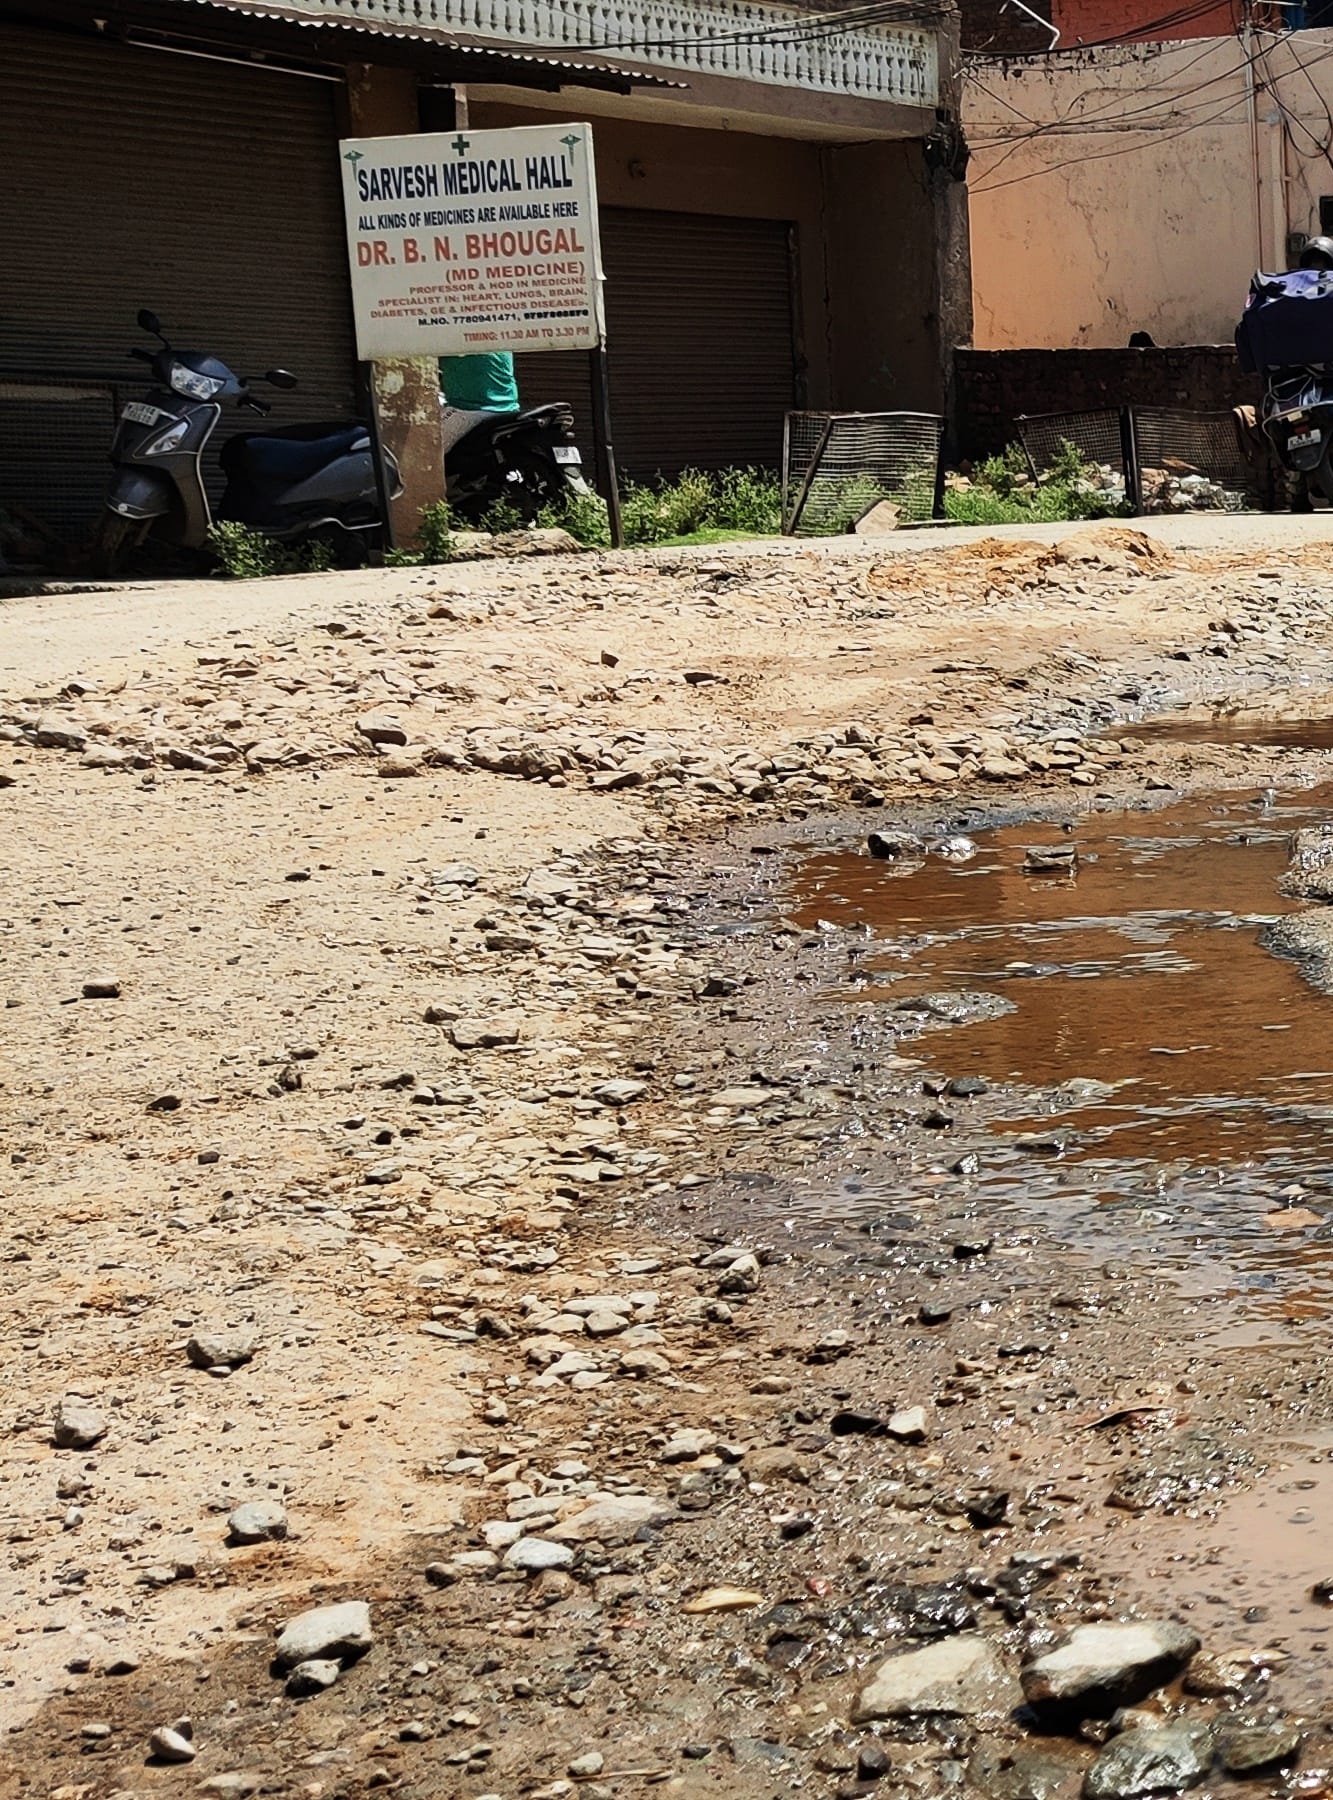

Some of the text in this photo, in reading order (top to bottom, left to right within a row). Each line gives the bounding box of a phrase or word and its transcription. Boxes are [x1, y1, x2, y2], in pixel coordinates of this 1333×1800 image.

[358, 155, 572, 201] SARVESH MEDICAL HALL
[359, 202, 578, 231] ALL KINDS OF MEDICINES ARE AVAILABLE HERE
[357, 227, 584, 267] DR. B. N. BHOUGAL
[446, 261, 585, 284] (MD MEDICINE)
[410, 284, 474, 294] PROFESSOR
[490, 281, 514, 290] HOD
[517, 280, 529, 288] IN
[532, 277, 586, 287] MEDICINE
[378, 296, 441, 307] SPECIALIST
[460, 302, 527, 313] INFECTIOUS
[525, 329, 539, 338] AM
[541, 329, 553, 338] TO
[576, 326, 590, 336] PM
